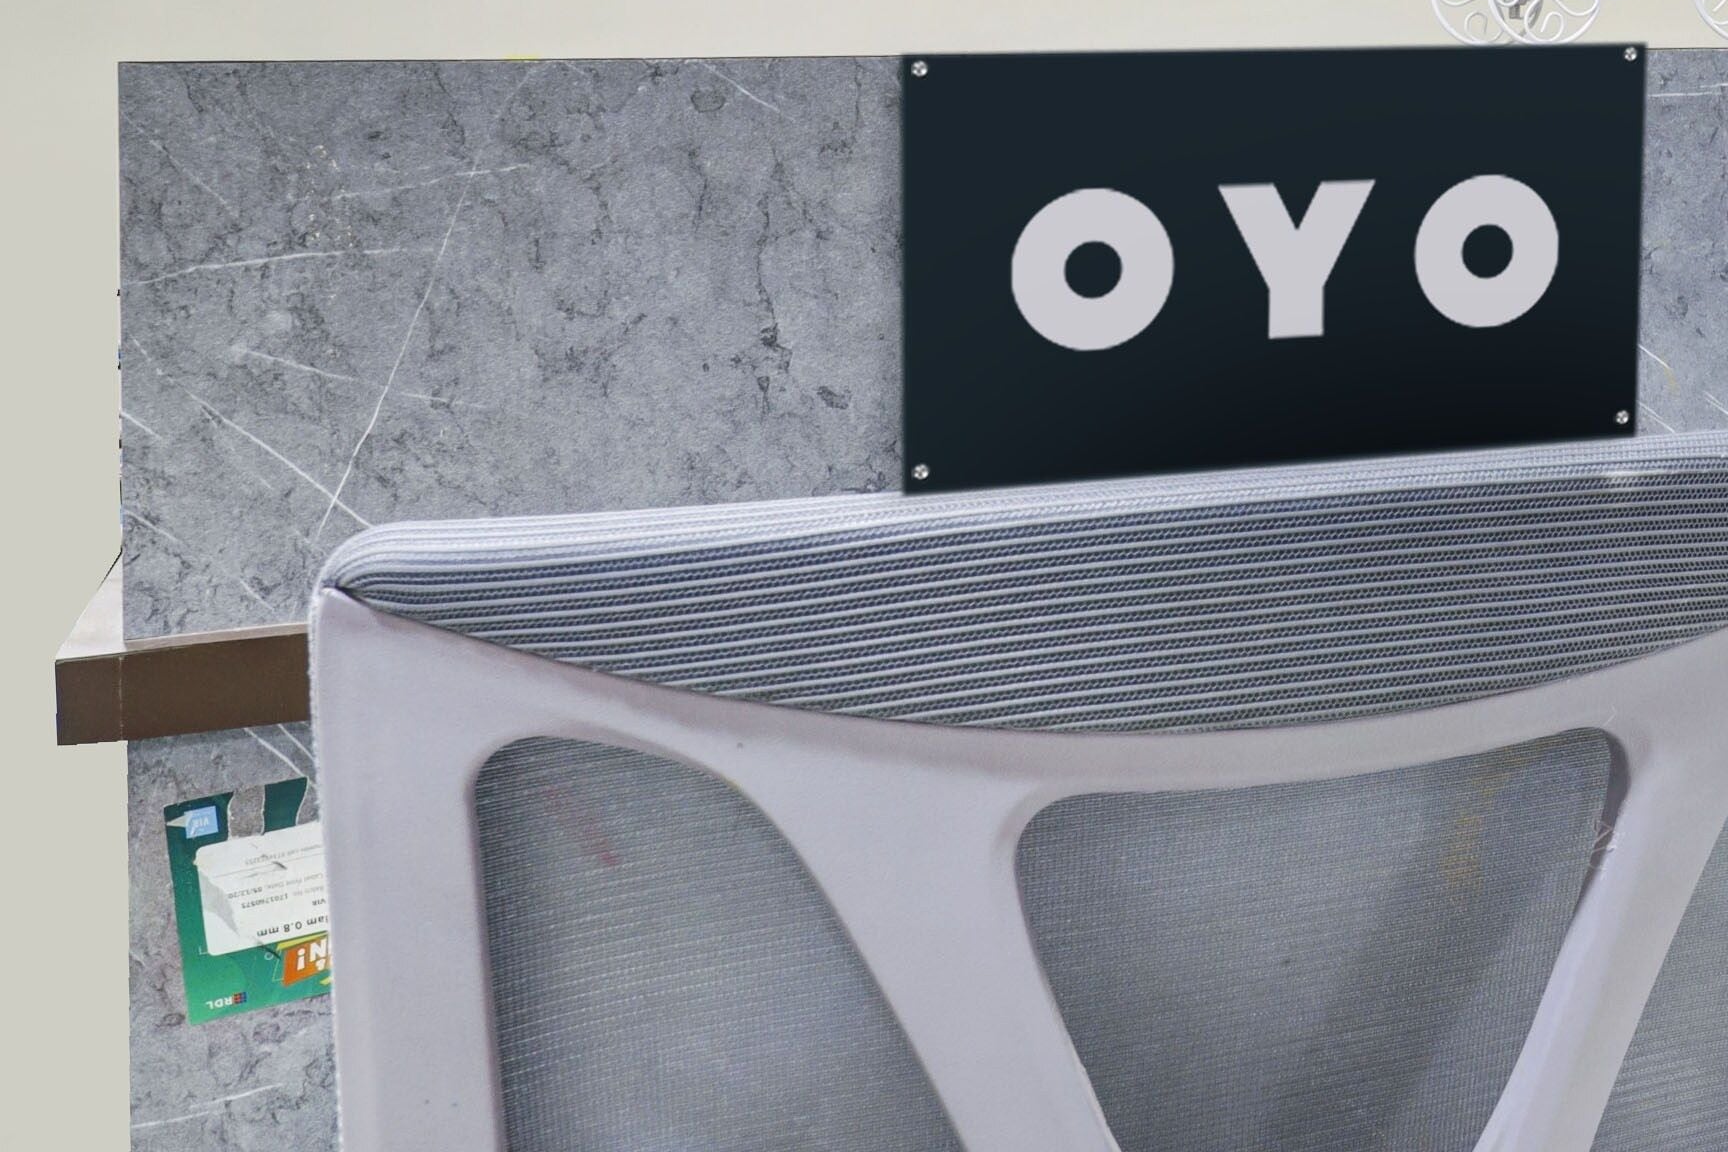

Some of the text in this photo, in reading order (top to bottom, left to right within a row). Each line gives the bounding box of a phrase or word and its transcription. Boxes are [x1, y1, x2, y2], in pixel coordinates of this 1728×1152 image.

[1011, 174, 1559, 351] OYO
[256, 926, 279, 937] mm
[283, 921, 302, 933] 0.8
[205, 995, 233, 1009] RDL
